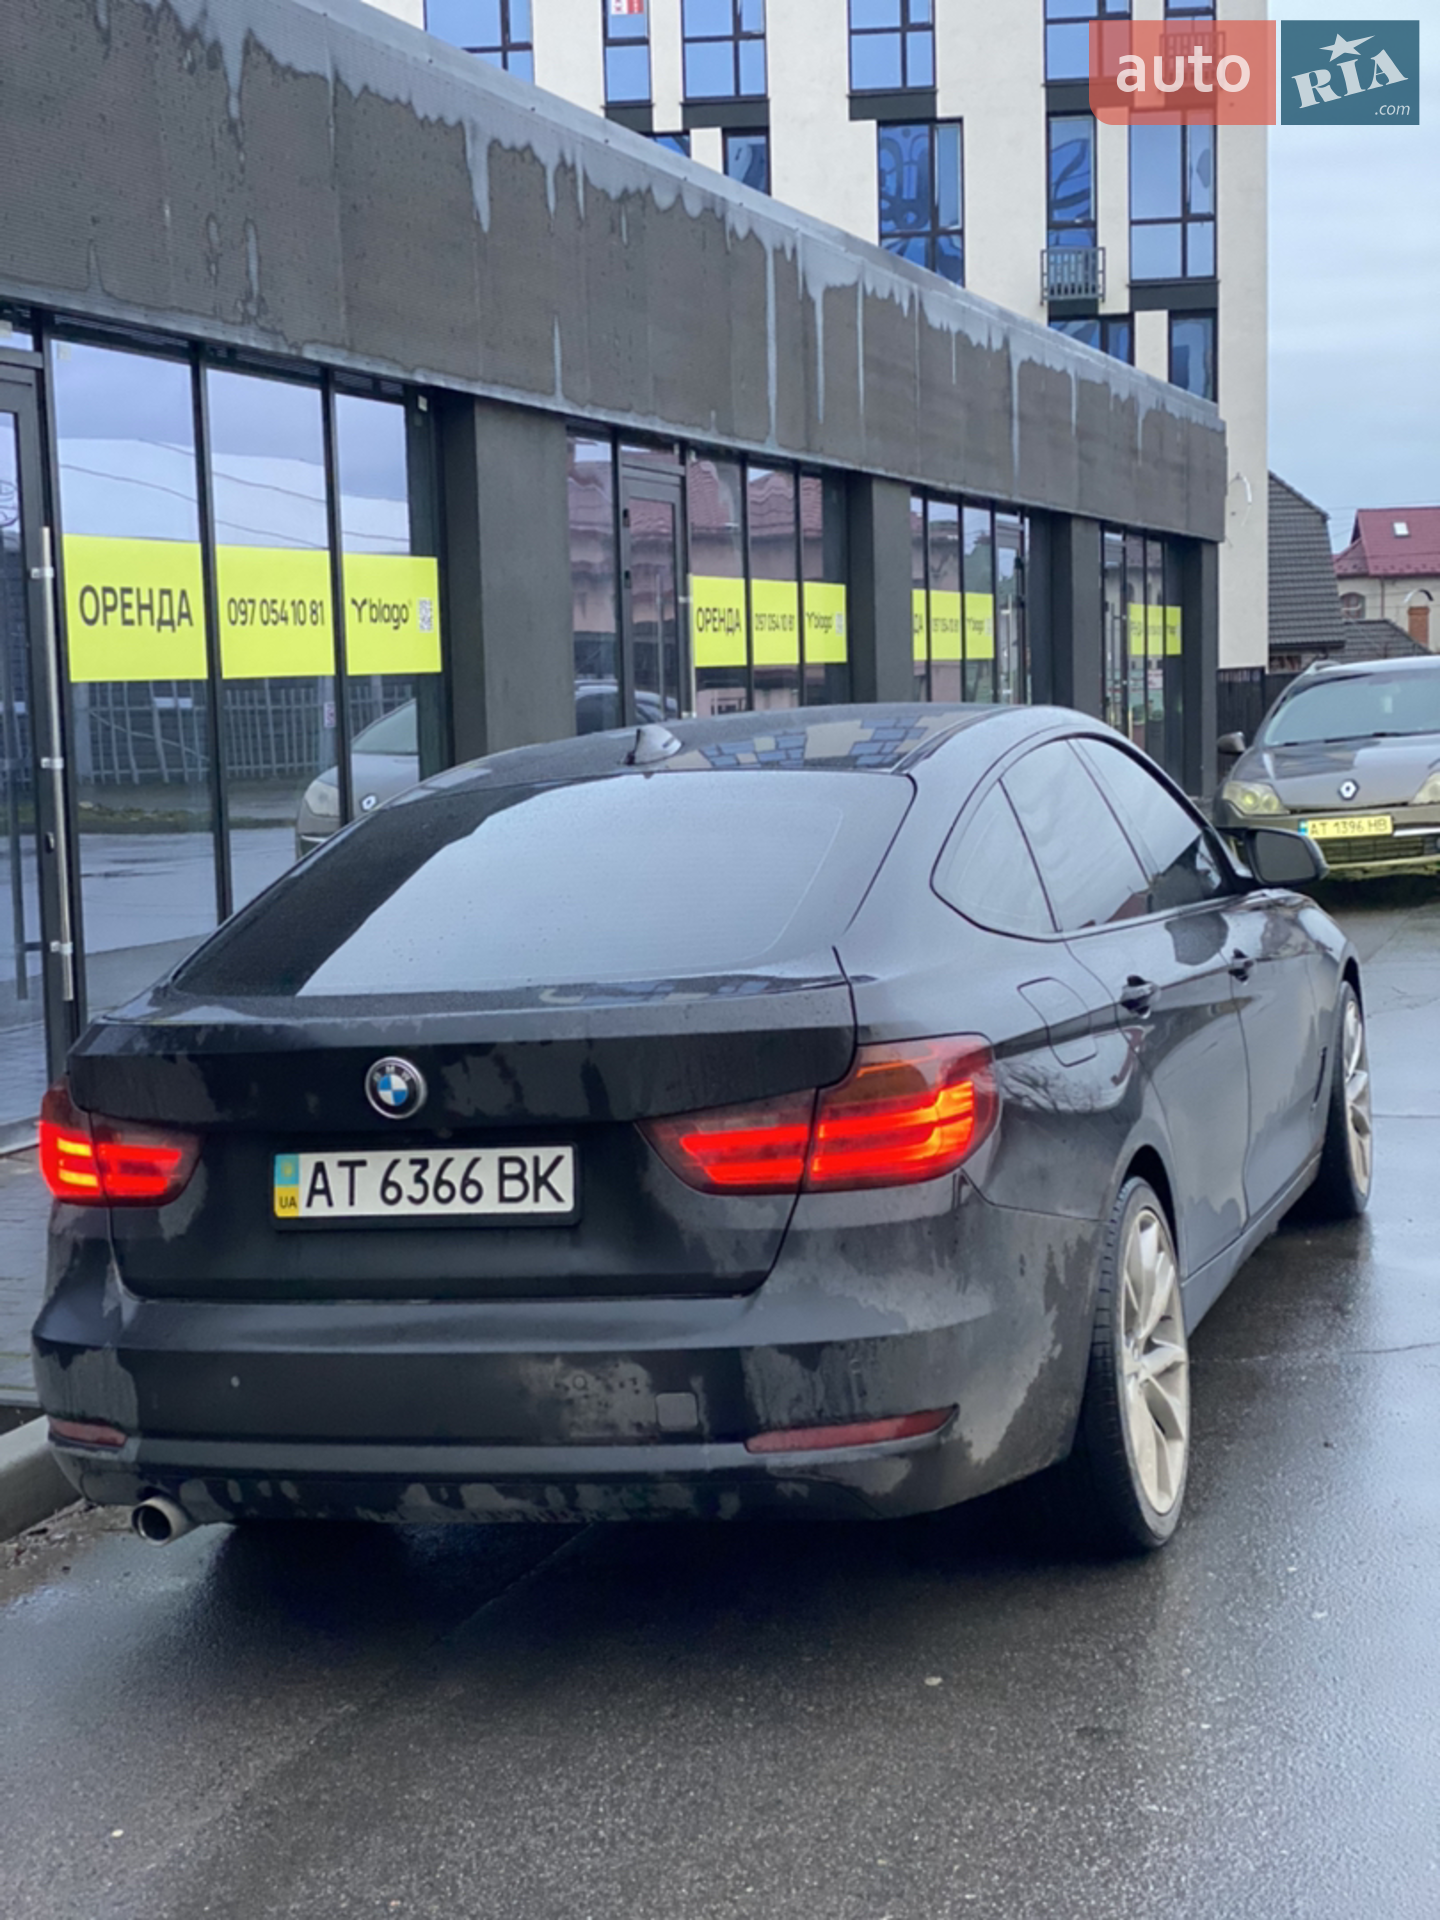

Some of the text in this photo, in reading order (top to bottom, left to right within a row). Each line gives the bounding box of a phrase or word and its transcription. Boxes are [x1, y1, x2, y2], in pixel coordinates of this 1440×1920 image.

[79, 584, 194, 633] ОРЕНДА
[696, 607, 741, 637] ОРЕНДА
[1310, 822, 1328, 835] AT
[306, 1155, 566, 1208] AT 6366 BK
[279, 1197, 298, 1209] UA
